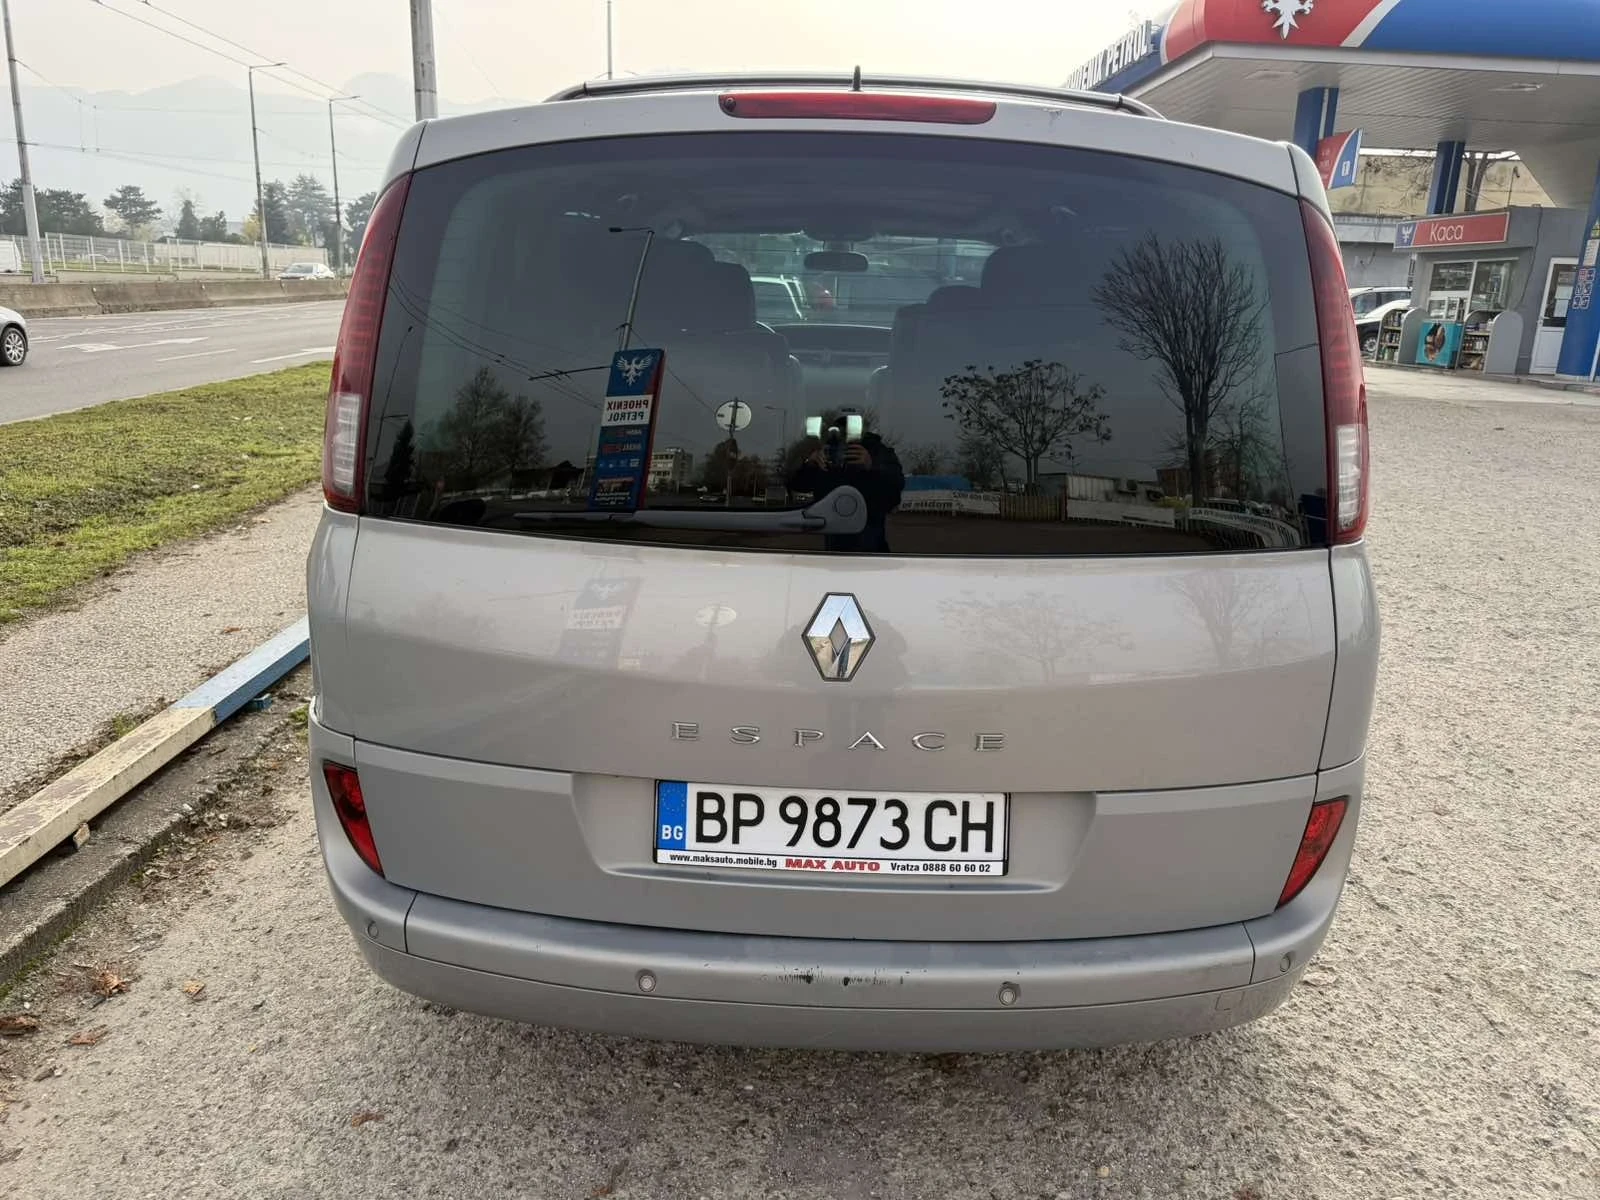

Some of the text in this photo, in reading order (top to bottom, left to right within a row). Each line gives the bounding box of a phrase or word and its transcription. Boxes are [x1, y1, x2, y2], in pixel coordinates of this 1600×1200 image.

[1105, 20, 1152, 79] PETROL
[1429, 223, 1464, 242] Каса
[671, 721, 1007, 752] ESPACE
[661, 824, 684, 841] BG
[695, 791, 995, 853] BP 9873 CH
[669, 852, 991, 874] www.maksauto.mobile.bg MAX AUTO Vratza 0888 60 60 02
